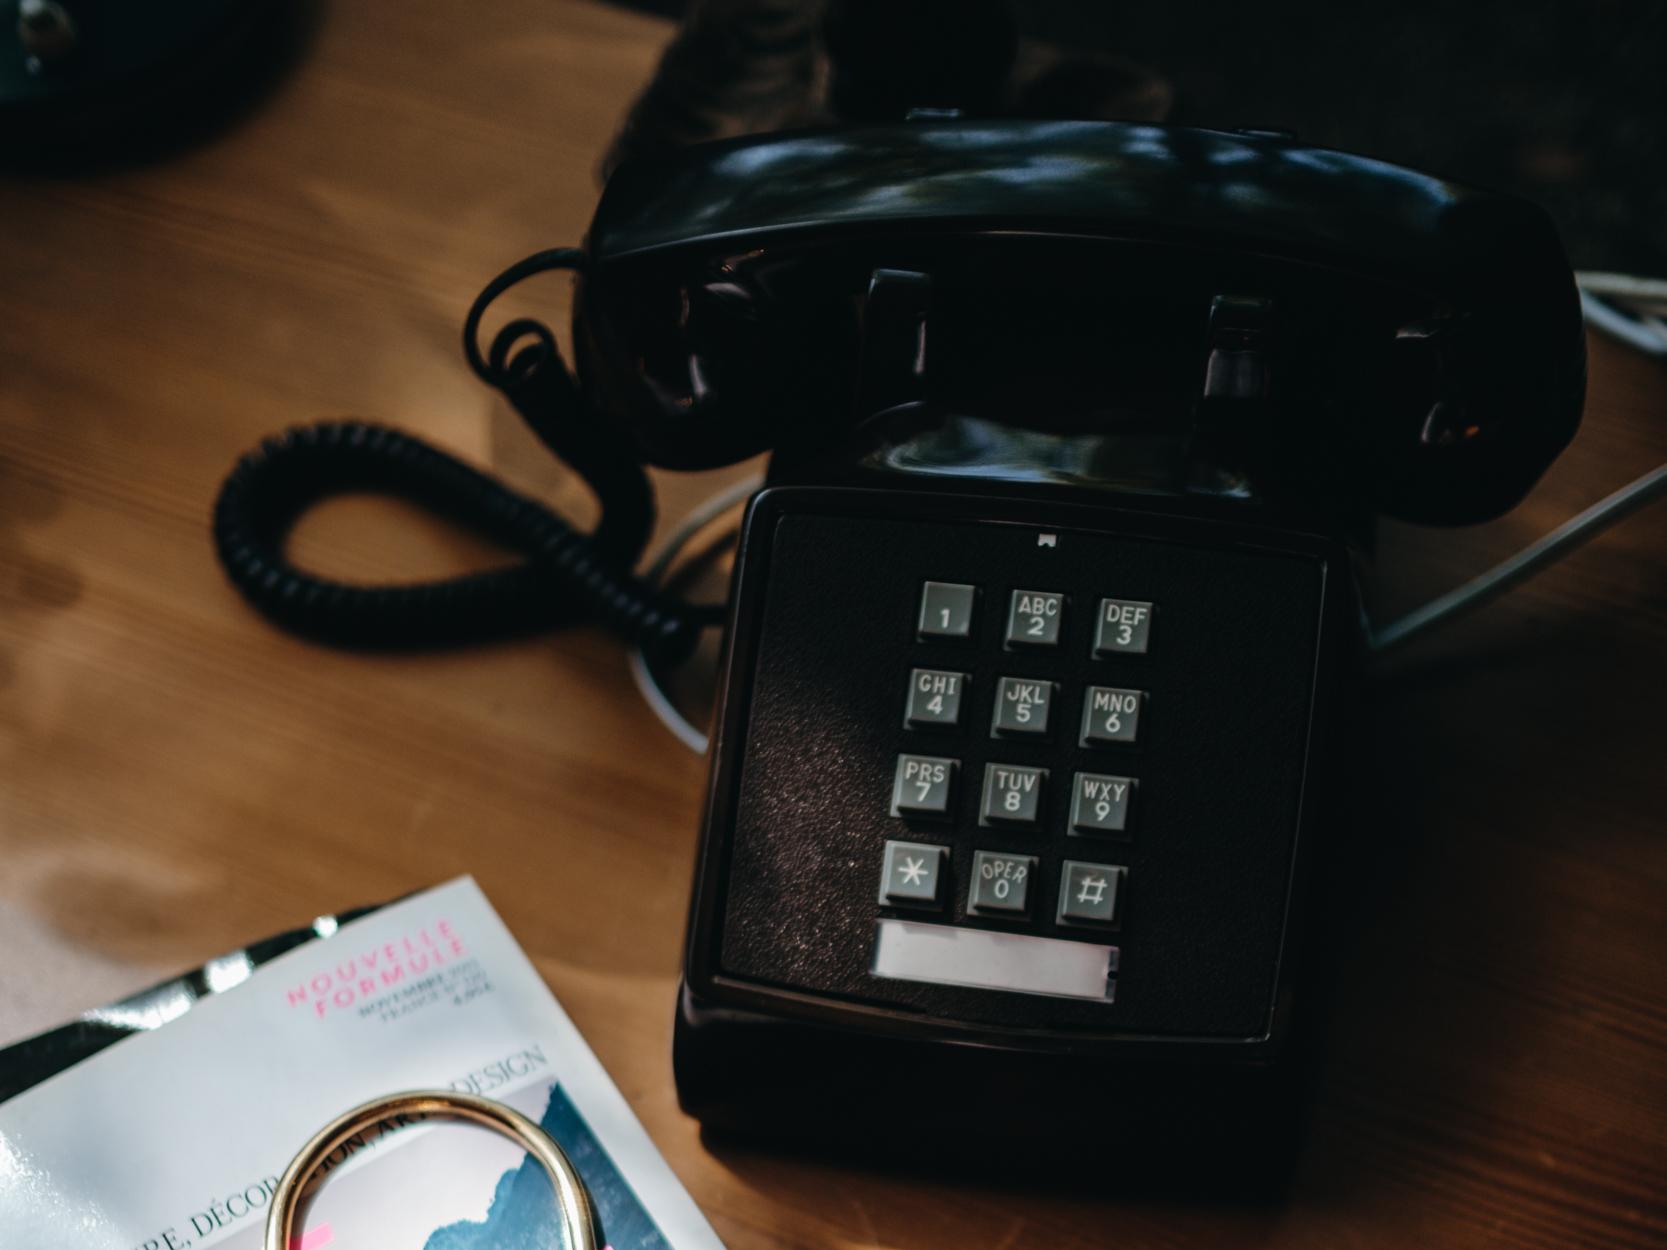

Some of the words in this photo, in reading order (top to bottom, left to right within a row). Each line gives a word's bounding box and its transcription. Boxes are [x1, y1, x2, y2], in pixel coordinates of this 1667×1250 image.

[1018, 596, 1058, 617] ABC
[1107, 605, 1148, 626] DEF
[939, 609, 951, 629] 1
[1028, 617, 1045, 636] 2
[1116, 626, 1132, 645] 3
[918, 674, 957, 695] GHI
[1006, 683, 1045, 704] JKL
[926, 695, 943, 716] 4
[1015, 703, 1031, 723] 5
[1094, 692, 1137, 714] MNO
[1105, 713, 1121, 734] 6
[905, 761, 945, 785] PRS
[998, 771, 1036, 793] TUV
[915, 783, 931, 802] 7
[1004, 791, 1021, 812] 8
[1084, 780, 1126, 802] WXY
[1094, 802, 1111, 822] 9
[981, 860, 1028, 883] OPER
[994, 880, 1009, 899] 0
[287, 919, 453, 1007] NOUVELLE
[314, 936, 471, 1020] FORMULE
[450, 1044, 549, 1098] DESIGN
